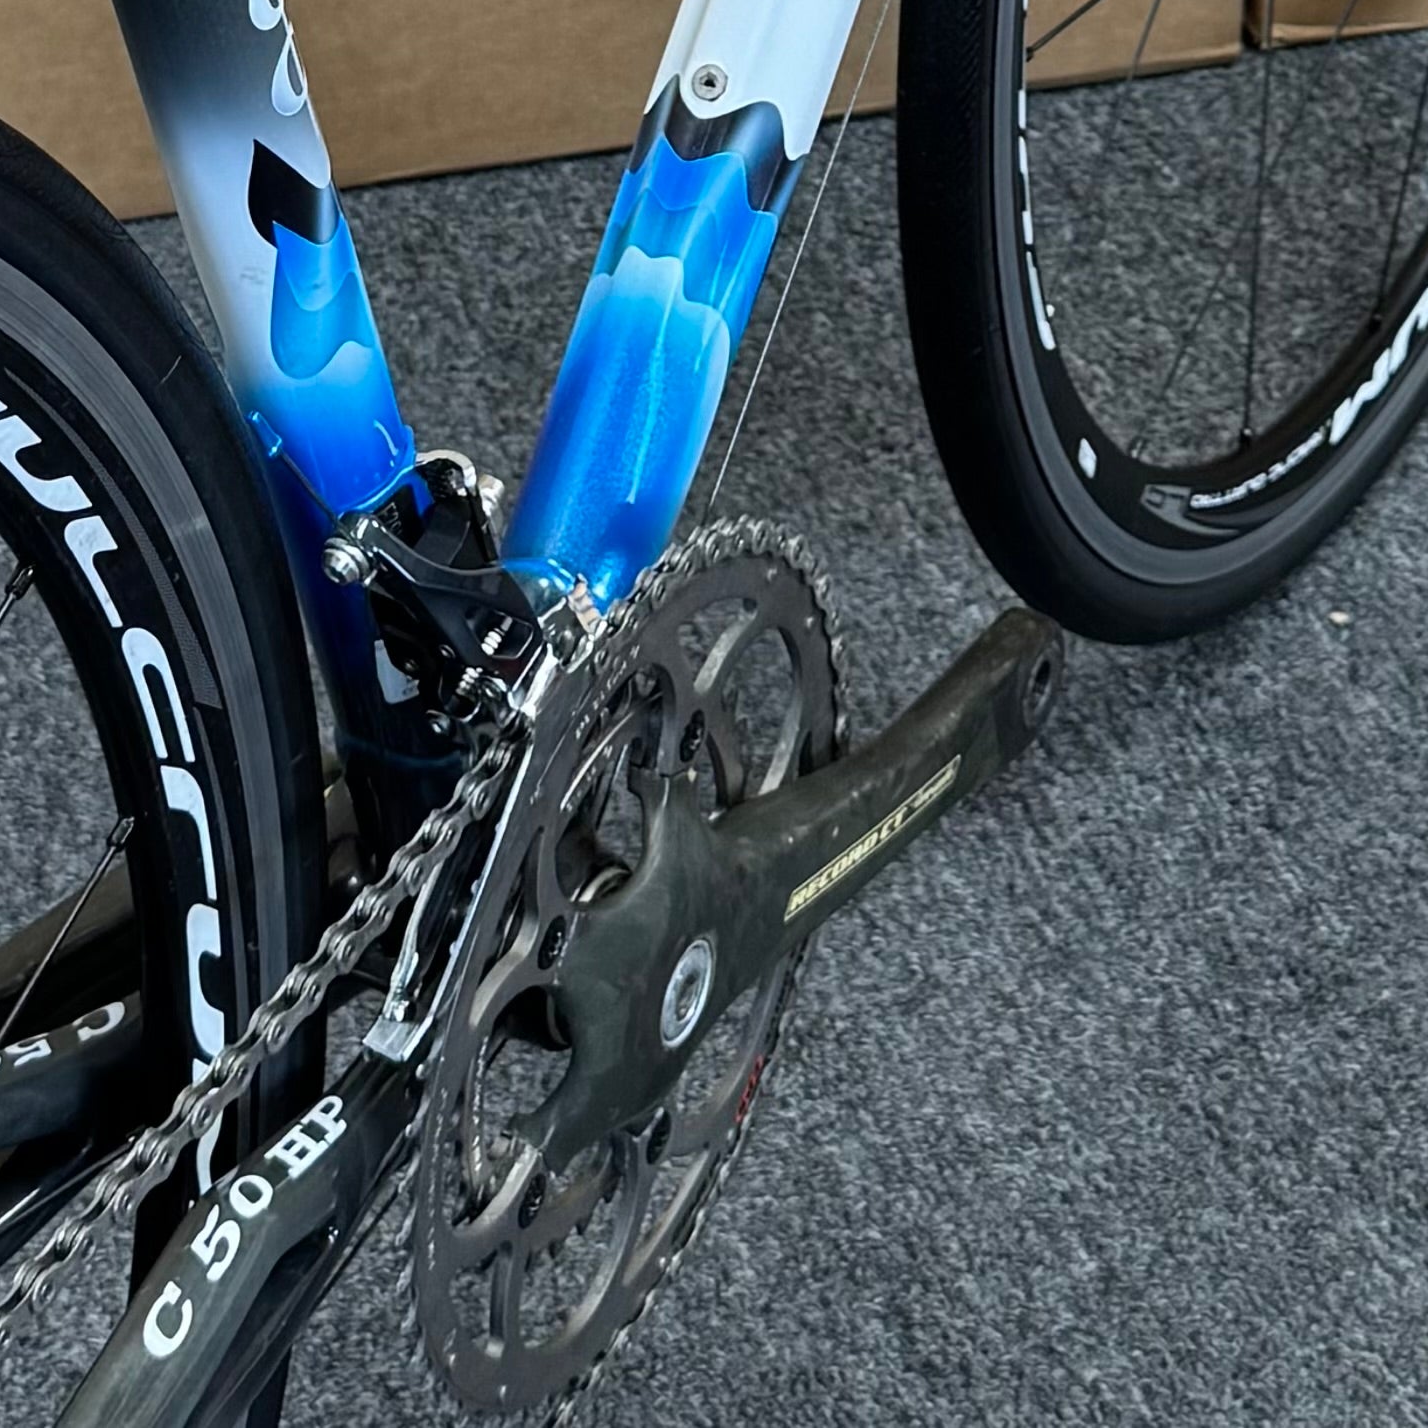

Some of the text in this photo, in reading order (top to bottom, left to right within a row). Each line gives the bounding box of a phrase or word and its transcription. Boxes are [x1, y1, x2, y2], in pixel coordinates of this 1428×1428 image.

[789, 831, 879, 912] RECORD
[141, 1094, 347, 1359] C 50 HP
